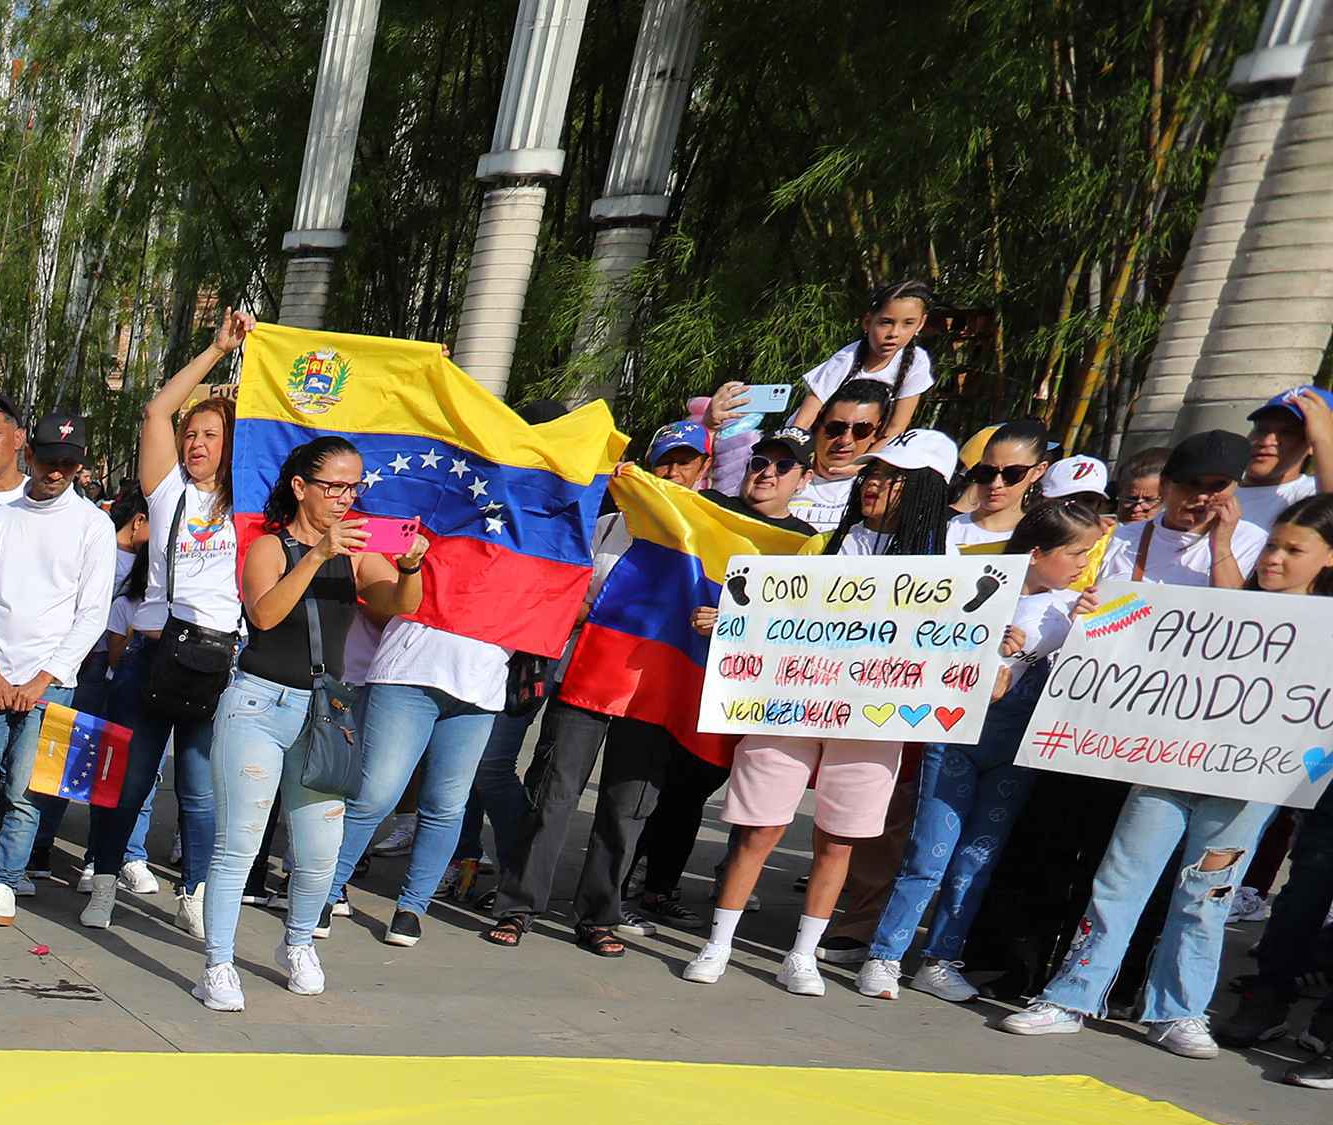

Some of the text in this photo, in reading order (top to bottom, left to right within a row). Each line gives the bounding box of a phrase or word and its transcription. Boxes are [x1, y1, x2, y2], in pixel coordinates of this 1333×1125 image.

[175, 539, 226, 553] ENEZUELA
[762, 573, 953, 606] CON LOS PIES
[716, 617, 990, 647] EN COLOMBIA PERO
[1148, 609, 1297, 664] AYUDA
[718, 655, 980, 687] CON EL ALMA EN
[1048, 655, 1274, 725] COMANDO
[721, 701, 852, 726] VENEZUELA
[1032, 721, 1303, 776] #VENEZUELALIBRE
